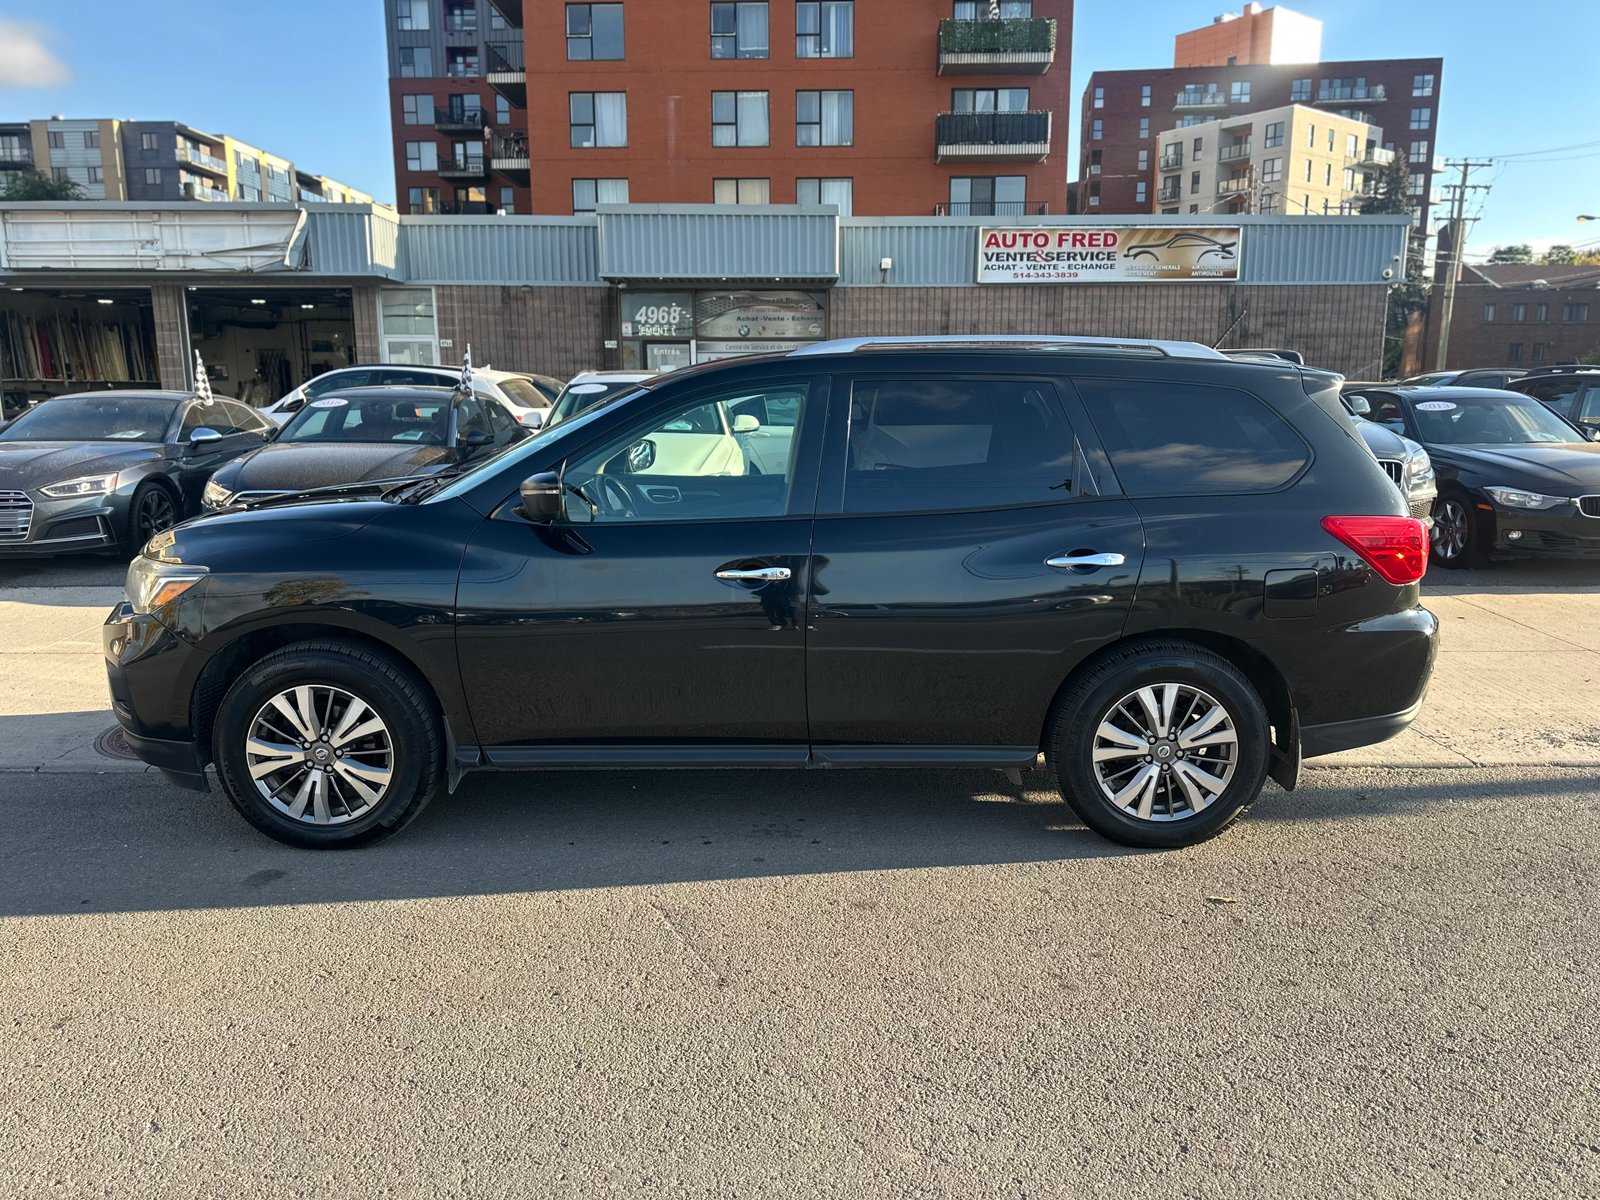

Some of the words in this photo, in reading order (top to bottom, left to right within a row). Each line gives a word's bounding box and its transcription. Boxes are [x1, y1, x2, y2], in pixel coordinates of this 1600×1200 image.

[984, 232, 1050, 249] AUTO
[1057, 232, 1118, 248] FRED
[635, 306, 680, 324] 4968
[653, 347, 681, 355] Entrée
